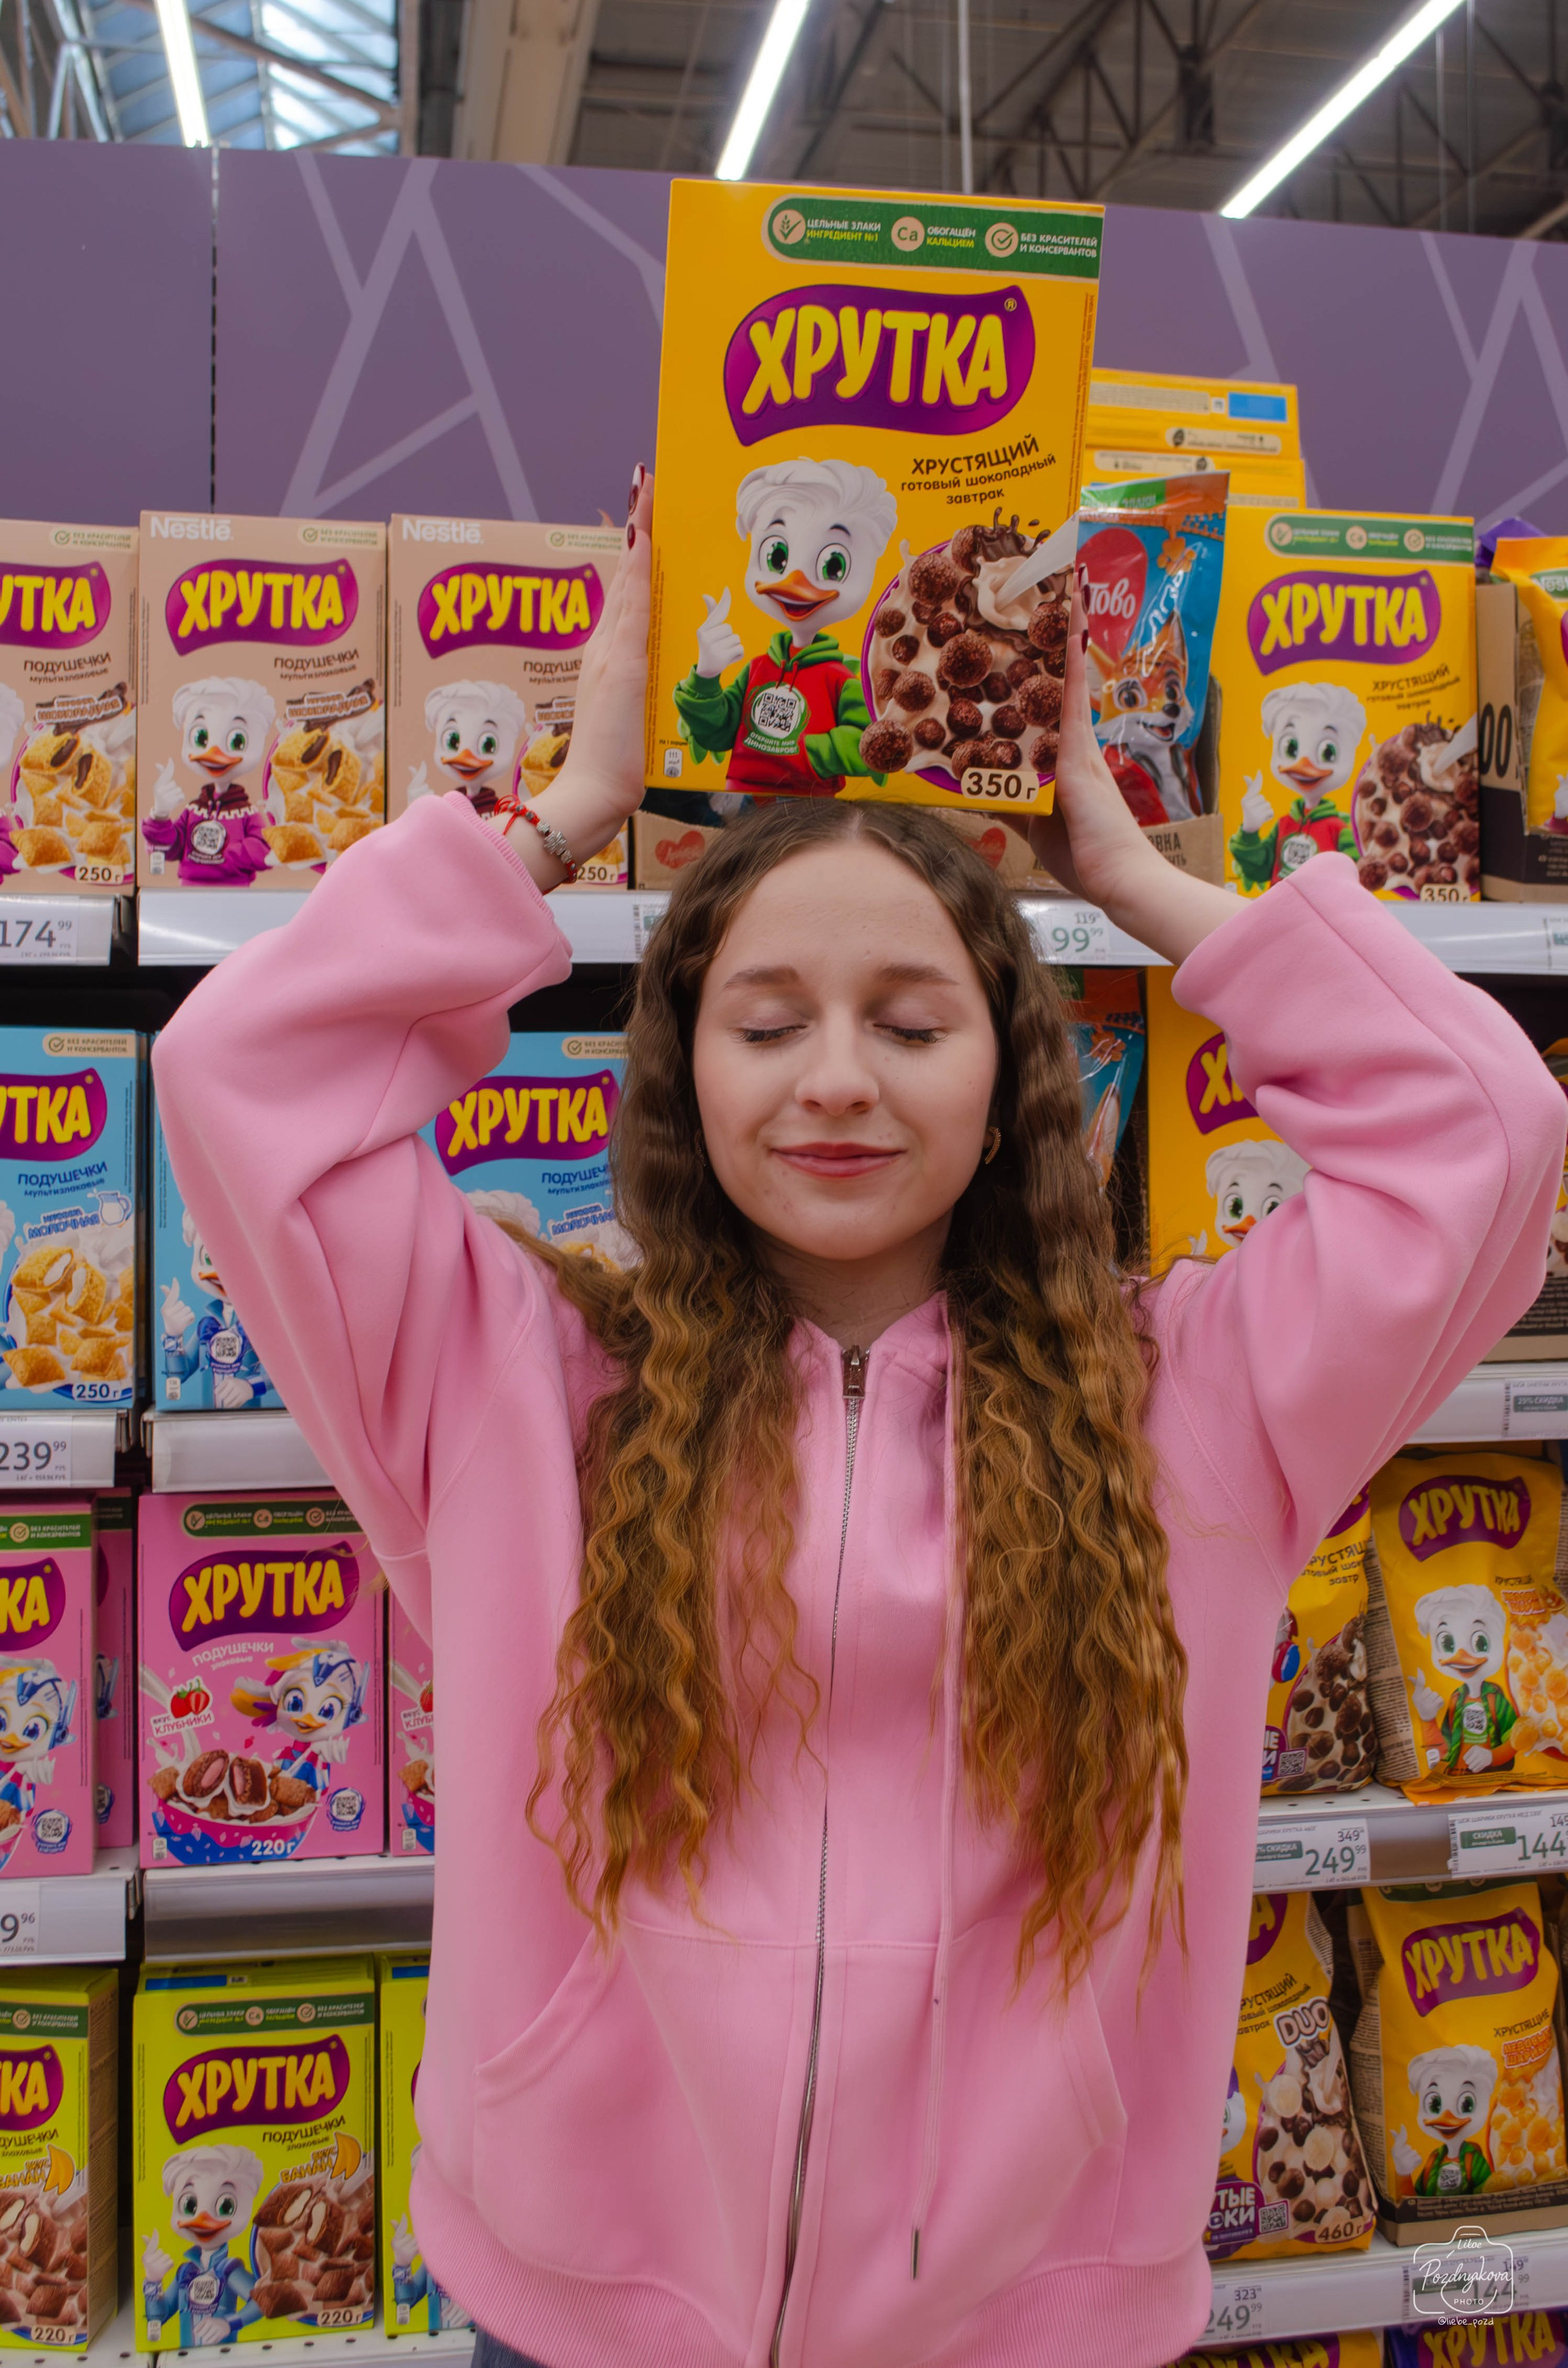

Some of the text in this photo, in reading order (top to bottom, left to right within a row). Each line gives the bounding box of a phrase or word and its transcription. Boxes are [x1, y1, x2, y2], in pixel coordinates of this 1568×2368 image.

[806, 229, 863, 241] ИНГРЕДИЕНТ
[807, 219, 881, 232] ЦЕЛЬНЫЕ ЗЛАКИ
[897, 225, 918, 243] Ca
[927, 225, 976, 238] ОБОГАЩЁН
[926, 236, 975, 248] КАЛЬЦИЕМ
[1020, 232, 1098, 248] БЕЗ КРАСИТЕЛЕЙ
[1020, 244, 1097, 258] И КОНСЕРВАНТОВ
[741, 305, 1008, 415] ХРУТКА
[911, 433, 1039, 475] ХРУСТЯЩИЙ
[901, 453, 1056, 492] готовый шоколадный
[946, 488, 1005, 504] завтрак
[178, 570, 345, 638] ХРУТКА
[429, 573, 592, 641] ХРУТКА
[1259, 583, 1428, 656] ХРУТКА
[23, 651, 111, 675] ПОДУШЕЧКИ
[274, 649, 360, 671] ПОДУШЕЧКИ
[523, 660, 582, 675] ПОДУШЕ
[1371, 664, 1450, 692] ХРУСТЯЩИЙ
[966, 771, 1036, 800] 350 г
[78, 866, 111, 882] 250
[577, 866, 608, 880] 250
[1074, 913, 1097, 924] 119
[0, 920, 72, 948] 174 99
[1051, 926, 1091, 953] 99
[447, 1086, 609, 1157] ХРУТКА
[17, 1160, 108, 1188] ПОДУШЕЧКИ
[541, 1162, 609, 1186] ПОДУШЕЧ
[23, 1177, 105, 1198] мультизлаковые
[28, 1213, 100, 1239] МОЛОЧНАЯ
[75, 1383, 119, 1399] 250 г
[0, 1440, 67, 1470] 239 99
[1408, 1484, 1521, 1546] ХРУТКА
[181, 1559, 345, 1633] ХРУТКА
[191, 1641, 275, 1668] ПОДУШЕЧКИ
[154, 1713, 212, 1735] КЛУБНИКИ
[1266, 1842, 1298, 1853] СКИДКА
[1336, 1829, 1360, 1843] 349
[1517, 1831, 1566, 1861] 144
[1305, 1844, 1366, 1876] 249 99
[21, 1912, 36, 1924] 96
[1404, 1923, 1534, 1999] ХРУТКА
[1240, 1972, 1297, 2011] РУСТЯЩИЙ
[1276, 1998, 1329, 2046] DUO
[175, 2051, 337, 2128] ХРУТКА
[262, 2115, 347, 2144] ПОДУШЕЧКИ
[1216, 2187, 1256, 2210] ТЫЕ
[1317, 2221, 1354, 2241] 460
[1234, 2288, 1257, 2302] 323
[322, 2310, 352, 2326] 220
[34, 2328, 64, 2342] 220
